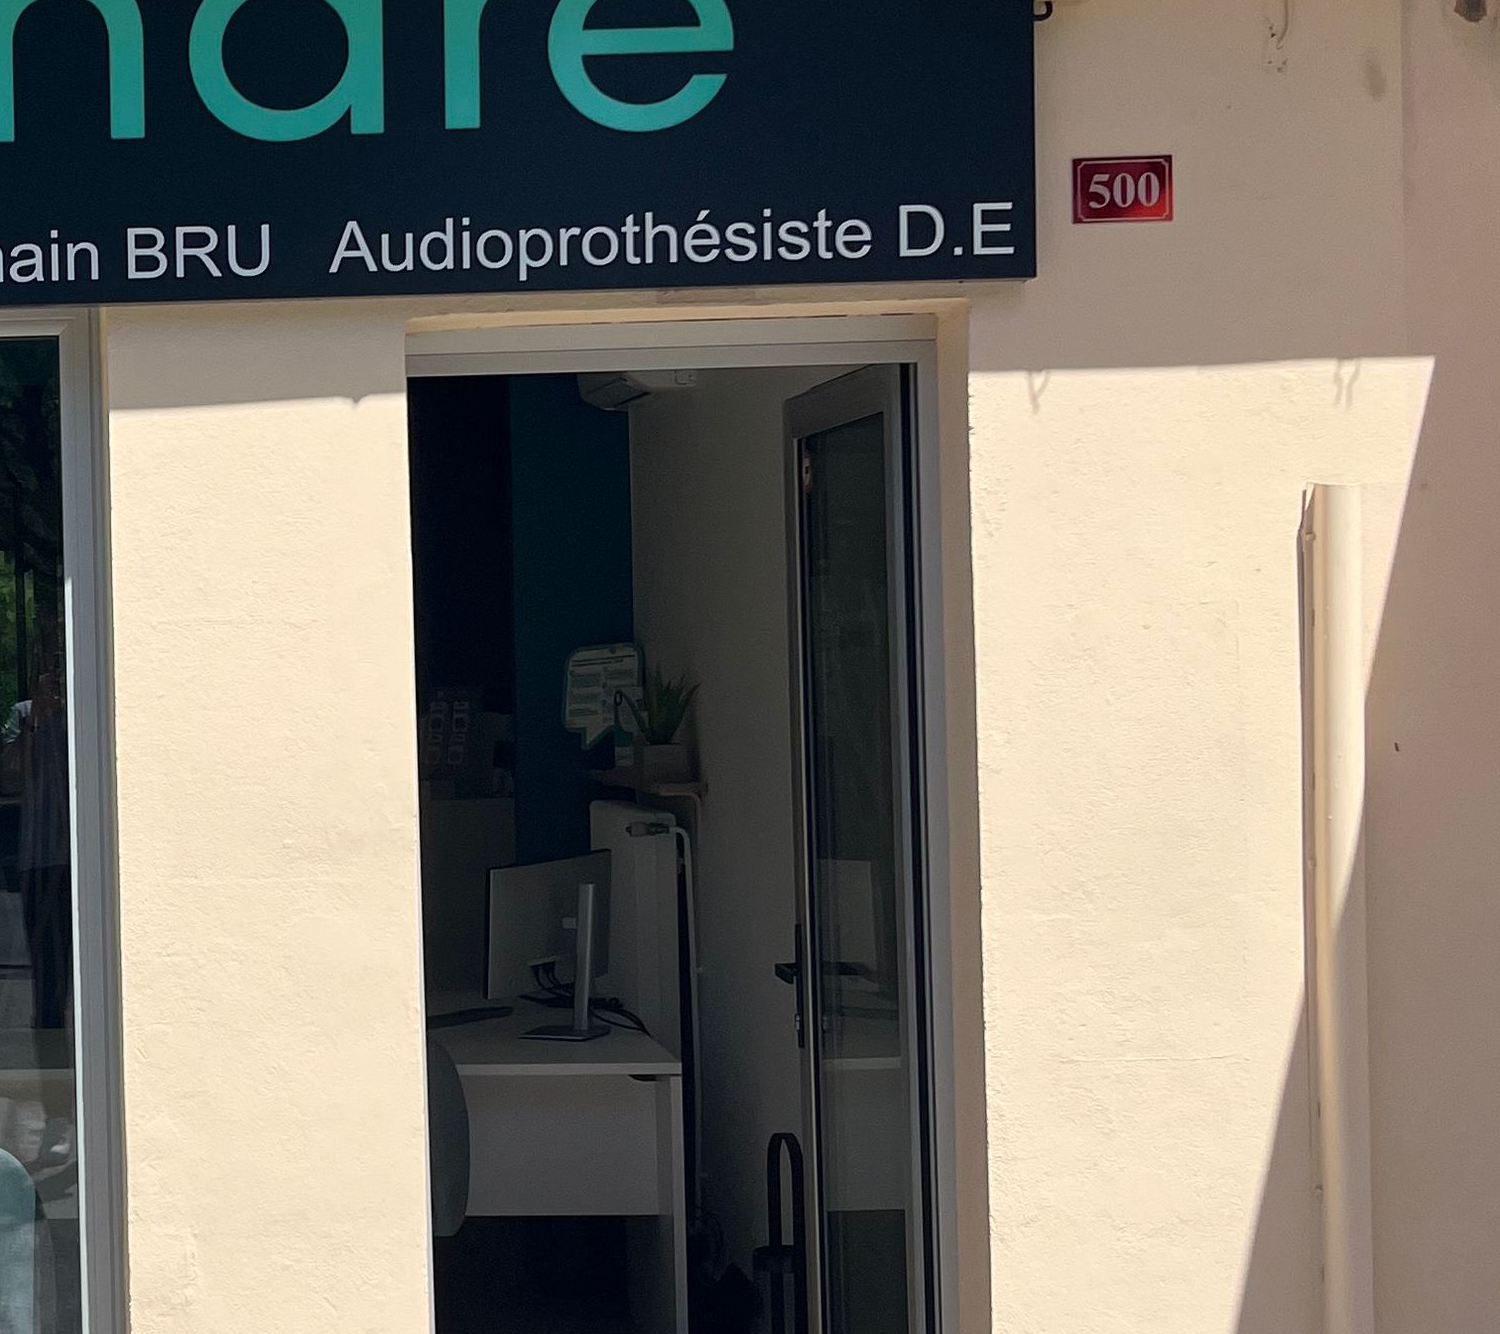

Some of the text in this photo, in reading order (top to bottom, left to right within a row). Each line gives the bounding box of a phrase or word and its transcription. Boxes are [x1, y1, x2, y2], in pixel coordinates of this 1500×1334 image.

[1087, 171, 1161, 209] 500
[126, 223, 270, 279] BRU
[328, 207, 872, 282] Audioprothésiste
[898, 201, 1015, 257] D.E
